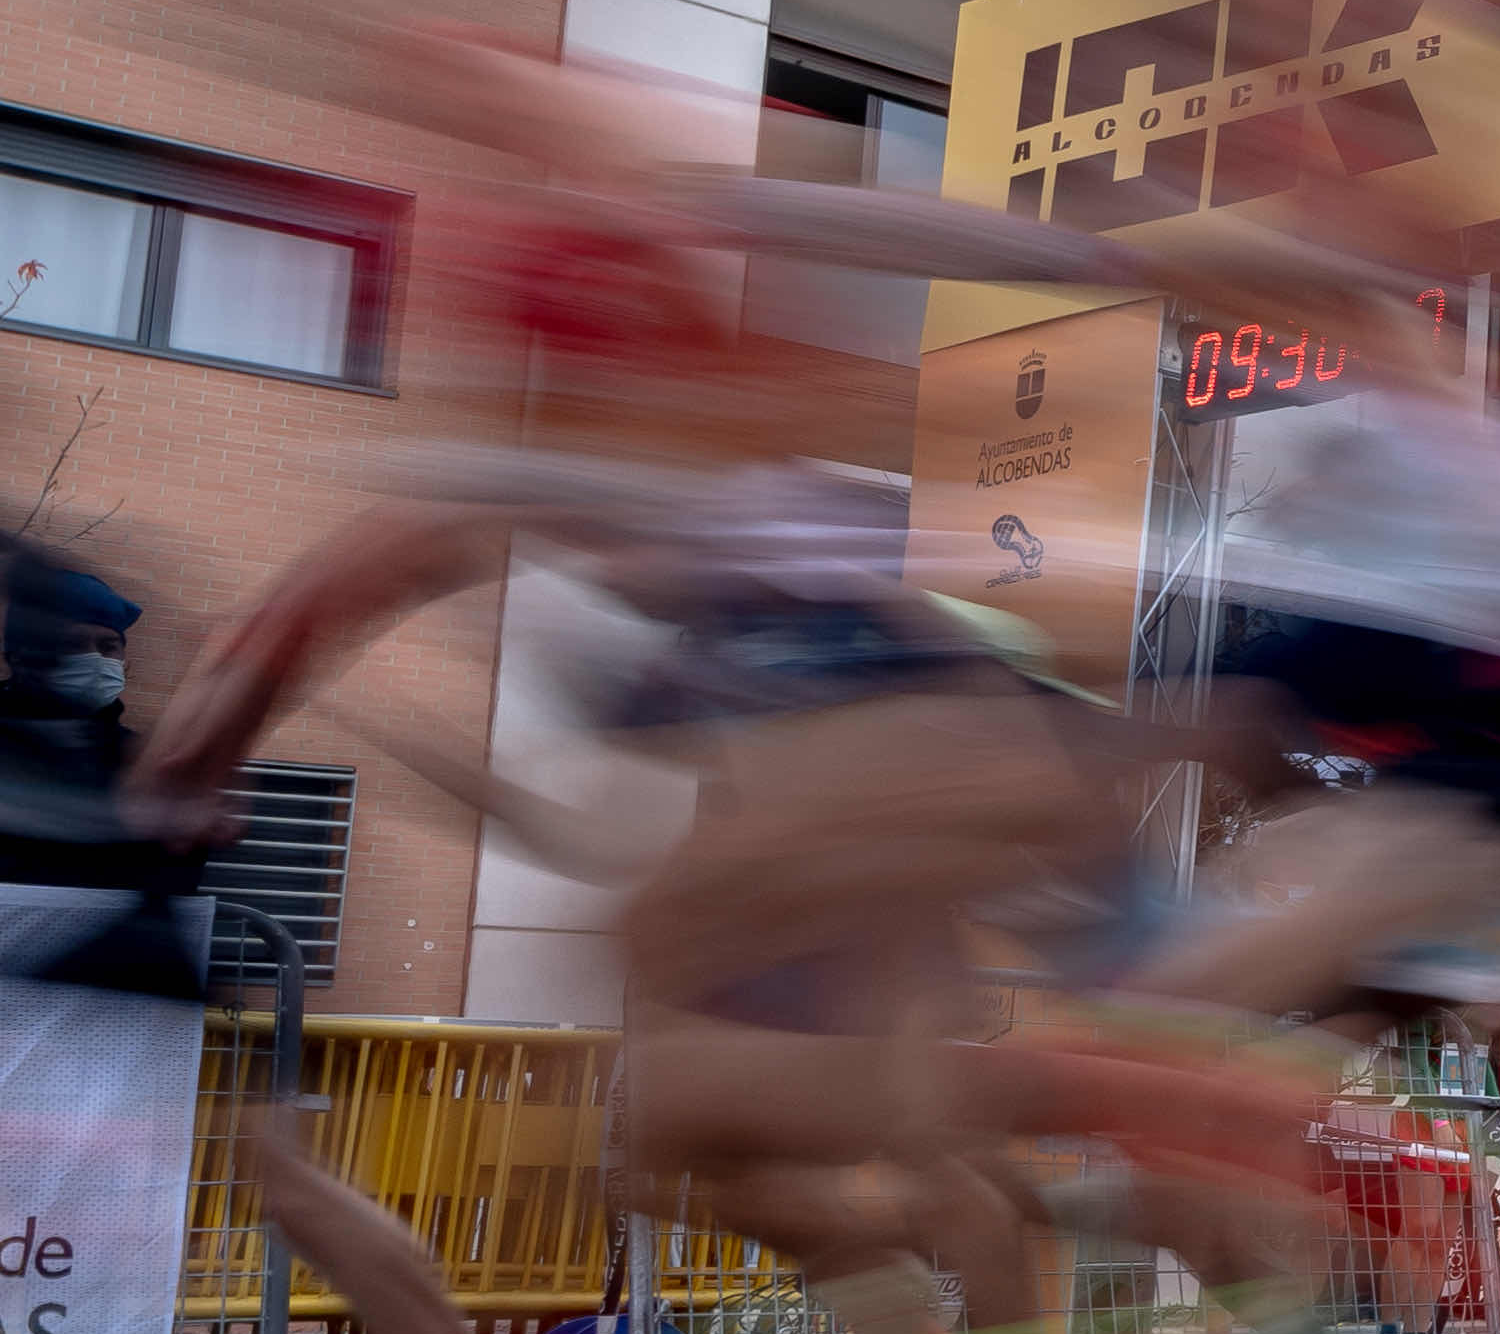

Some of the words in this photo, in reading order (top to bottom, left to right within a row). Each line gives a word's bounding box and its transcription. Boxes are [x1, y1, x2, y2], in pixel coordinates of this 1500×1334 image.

[1012, 33, 1441, 164] ALCOBENDAS
[978, 430, 1054, 461] Ayuntamiento
[1058, 422, 1073, 442] de
[975, 447, 1072, 491] ALCOBENDAS
[0, 1216, 74, 1279] de
